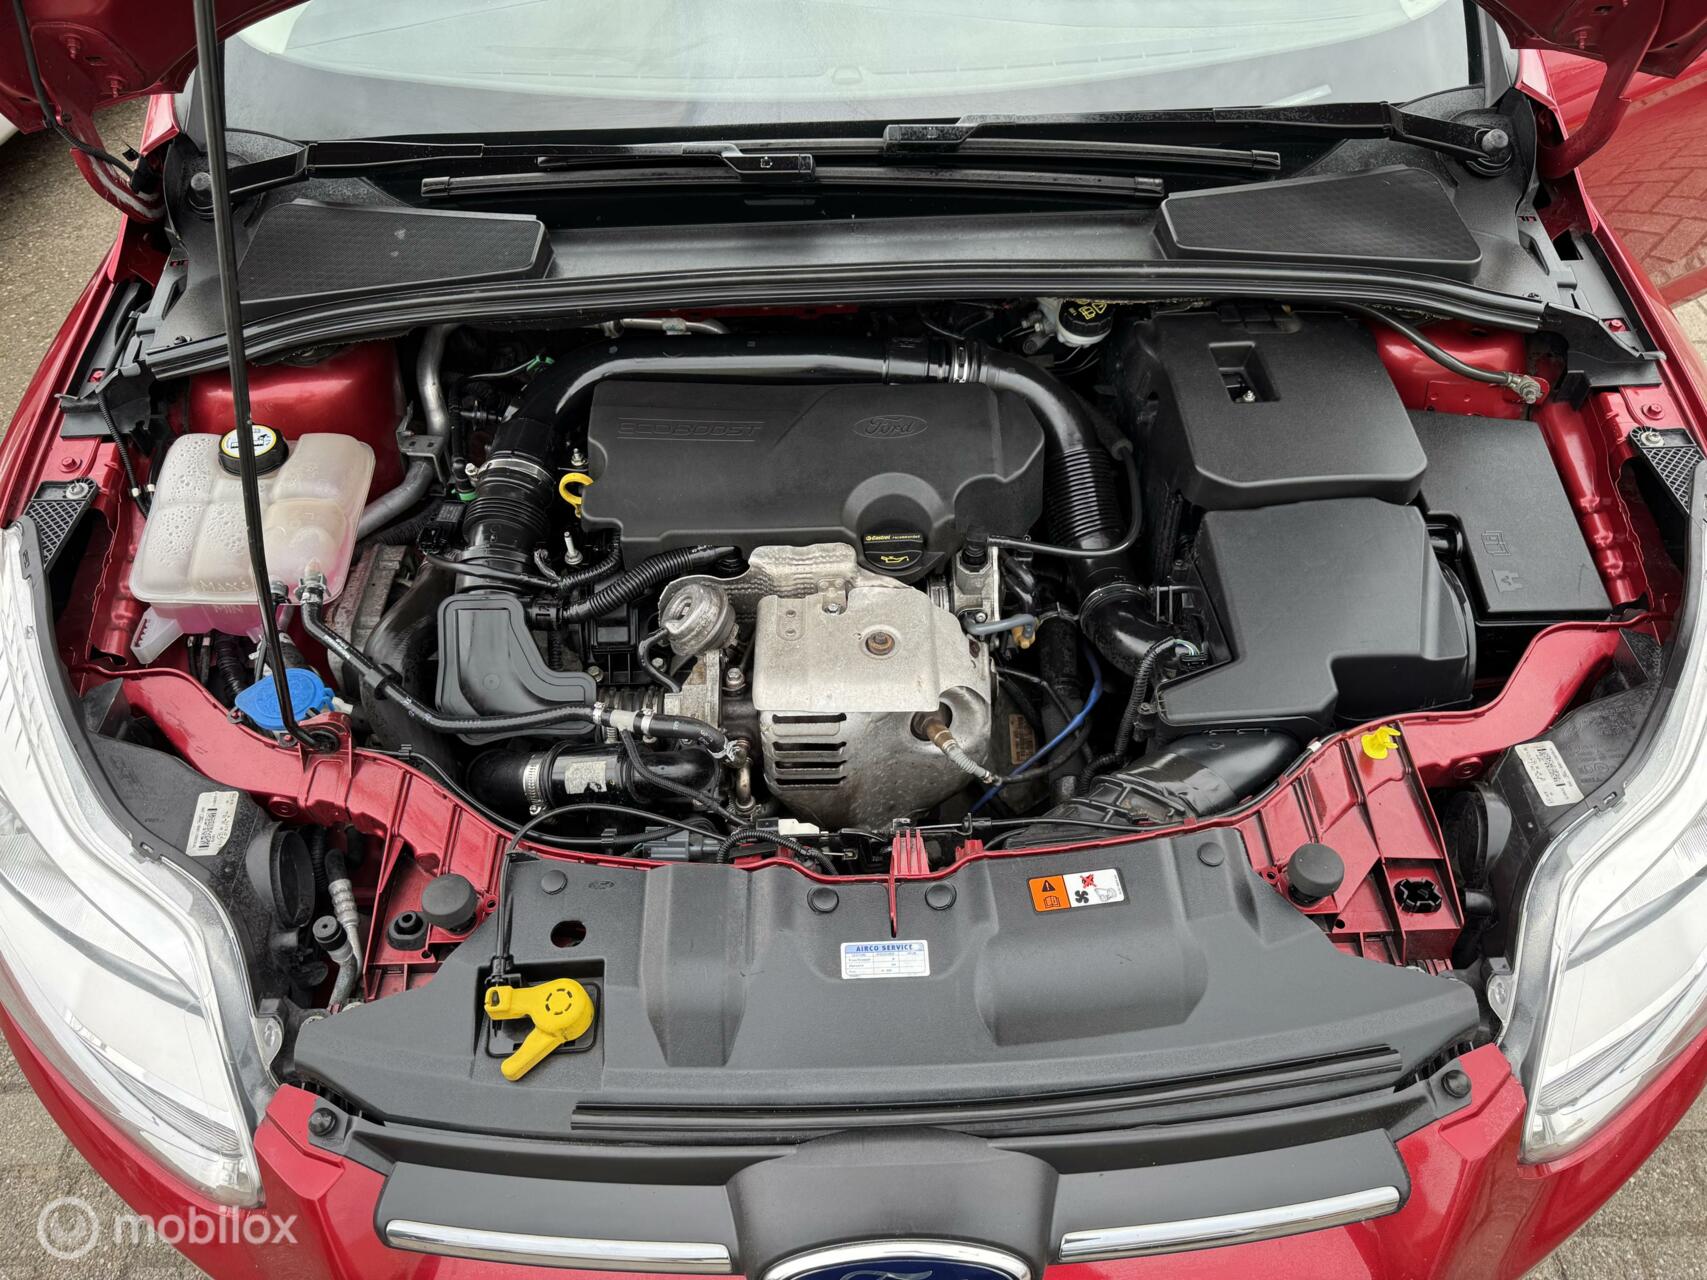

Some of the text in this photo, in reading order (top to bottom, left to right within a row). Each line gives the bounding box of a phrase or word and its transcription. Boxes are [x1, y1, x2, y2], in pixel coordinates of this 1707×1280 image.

[864, 416, 915, 436] Ford
[856, 943, 913, 952] AIRCO SERVICE
